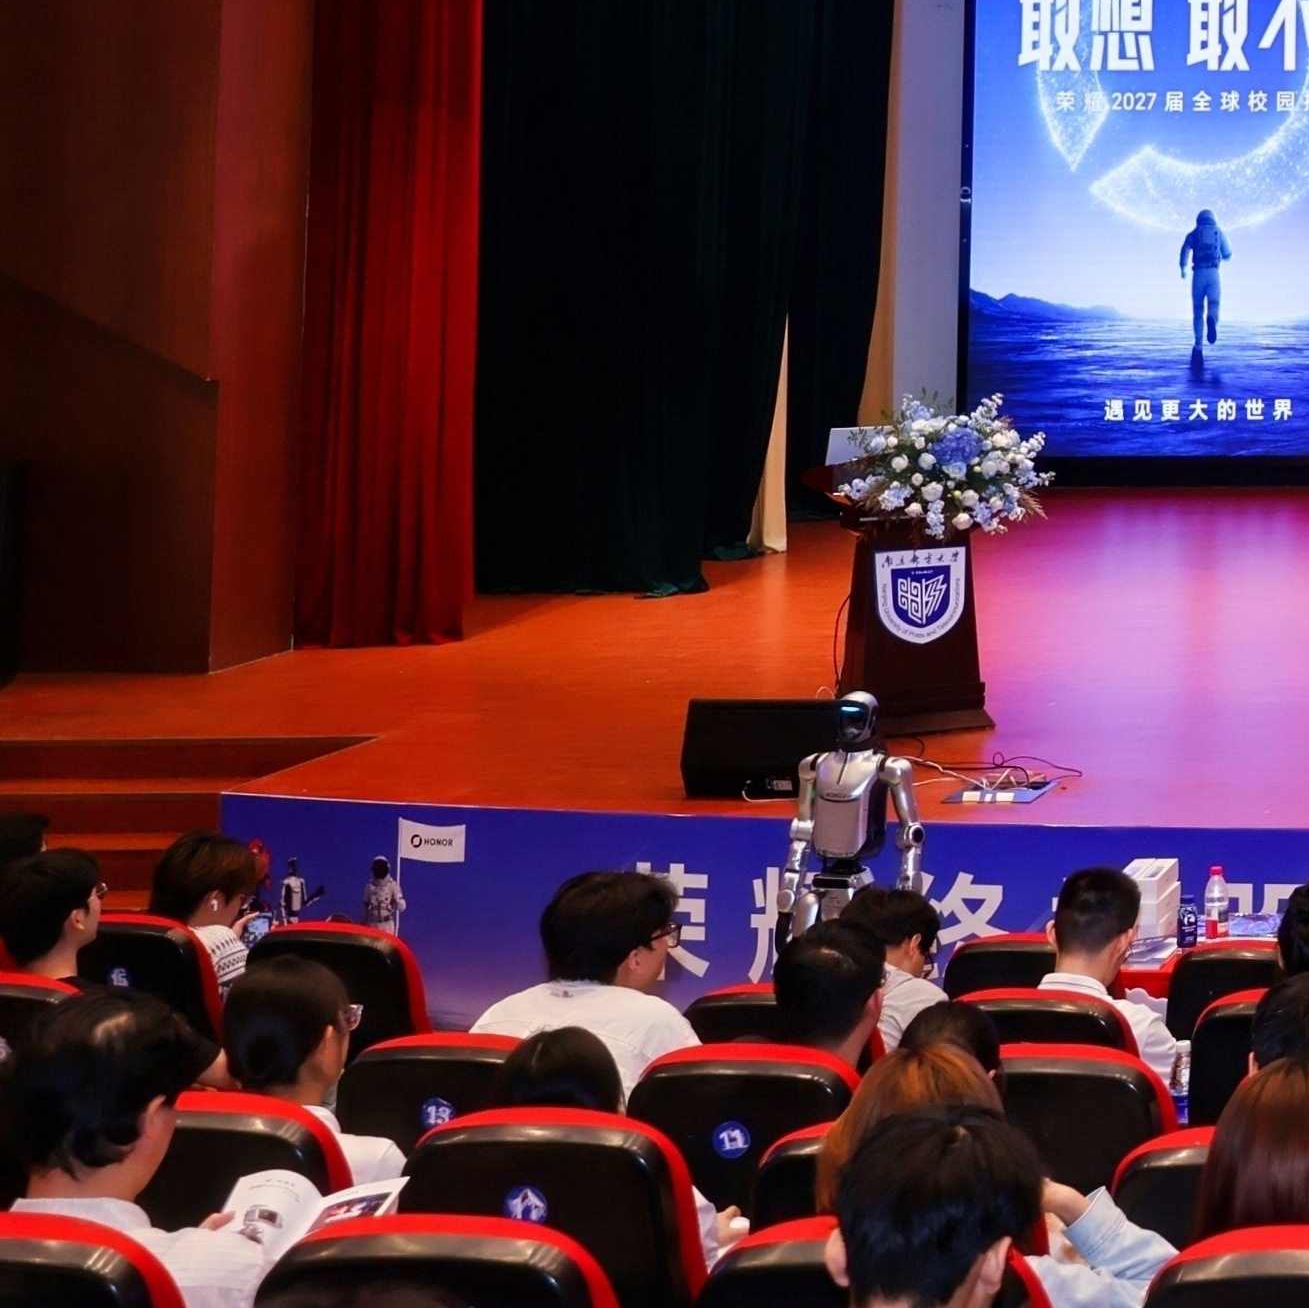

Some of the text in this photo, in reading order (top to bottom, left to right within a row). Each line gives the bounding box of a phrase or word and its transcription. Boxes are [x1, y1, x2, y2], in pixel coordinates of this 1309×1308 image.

[1104, 398, 1294, 422] 遇见更大的世界
[424, 838, 454, 847] HONOR
